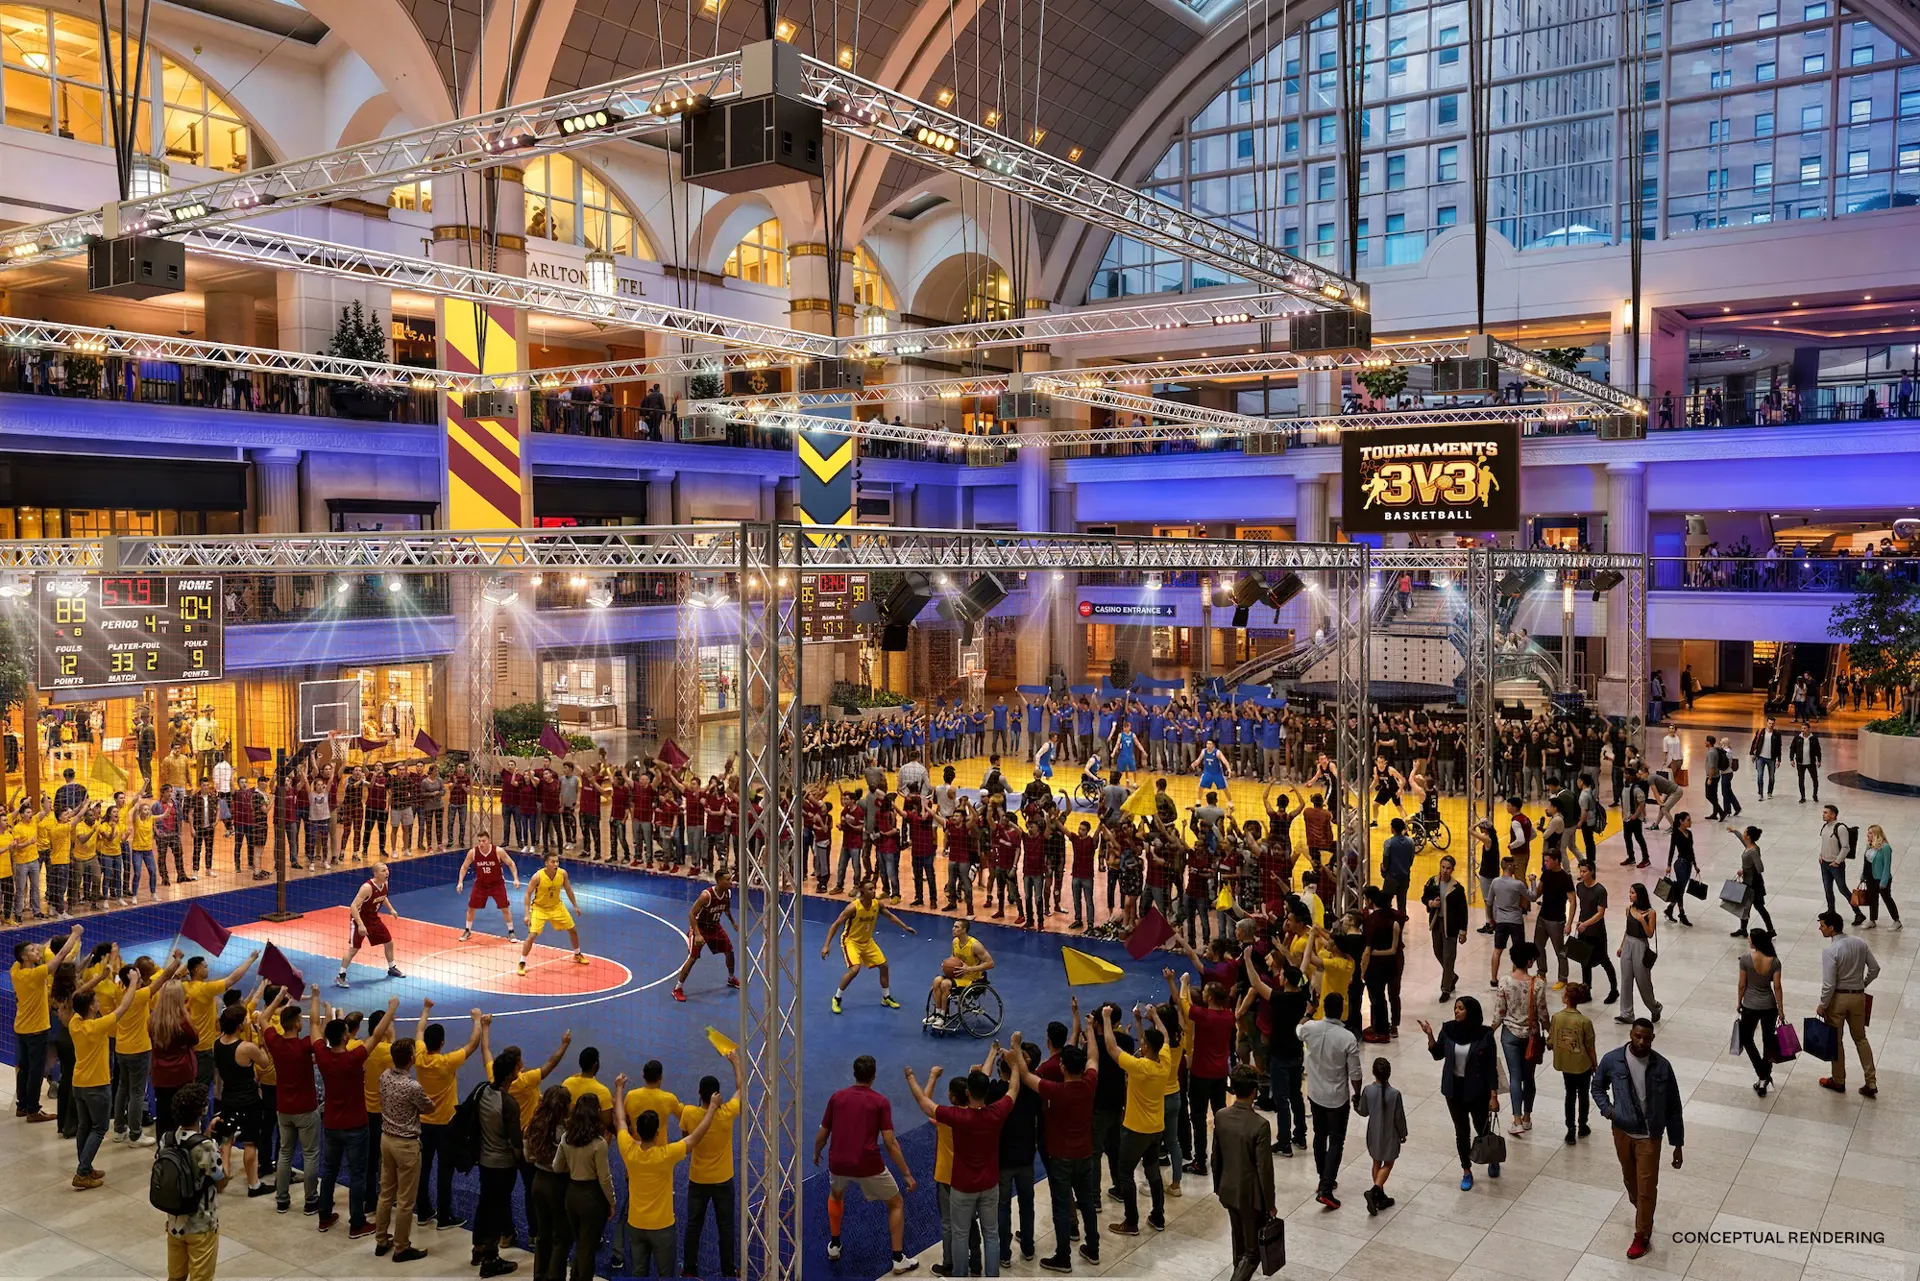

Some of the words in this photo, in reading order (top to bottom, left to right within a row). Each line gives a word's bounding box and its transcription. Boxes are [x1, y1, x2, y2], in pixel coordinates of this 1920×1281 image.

[617, 277, 647, 296] TEL
[1359, 442, 1498, 461] TOURNAMENTS
[1380, 461, 1477, 504] 3V3
[1384, 510, 1472, 521] BASKETBALL
[178, 580, 213, 591] HOME
[56, 598, 86, 624] 89
[180, 596, 212, 620] 104
[1095, 605, 1121, 613] CASINO
[1122, 606, 1161, 615] ENTRANCE
[101, 620, 139, 629] PERIOD
[145, 615, 156, 633] 4
[55, 645, 83, 653] FOULS
[183, 640, 208, 648] FOULS
[61, 655, 78, 675] 12
[111, 652, 134, 672] 33
[147, 651, 158, 671] 2
[193, 649, 204, 668] 9
[53, 677, 84, 685] POINTS
[108, 674, 137, 683] MATCH
